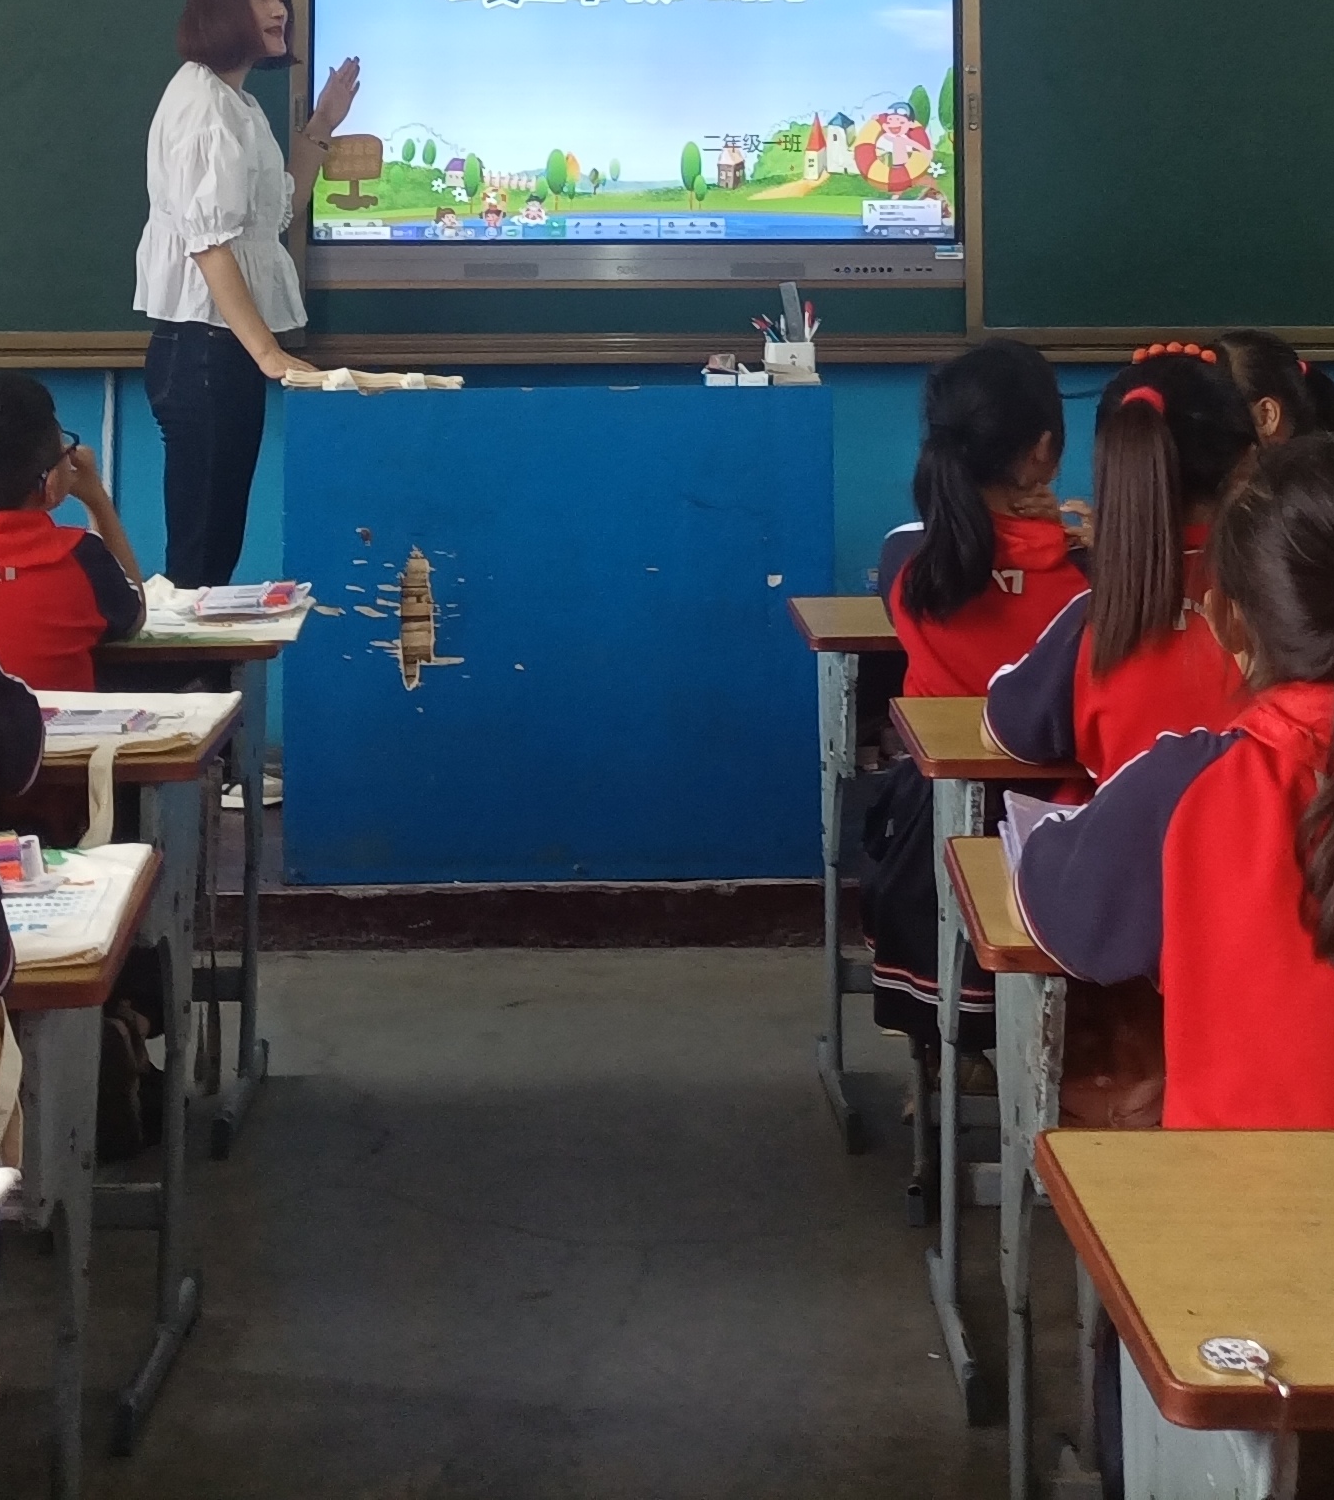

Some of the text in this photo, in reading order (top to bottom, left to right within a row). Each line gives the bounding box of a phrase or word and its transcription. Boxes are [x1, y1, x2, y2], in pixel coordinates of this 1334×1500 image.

[702, 133, 802, 153] 二年级一班
